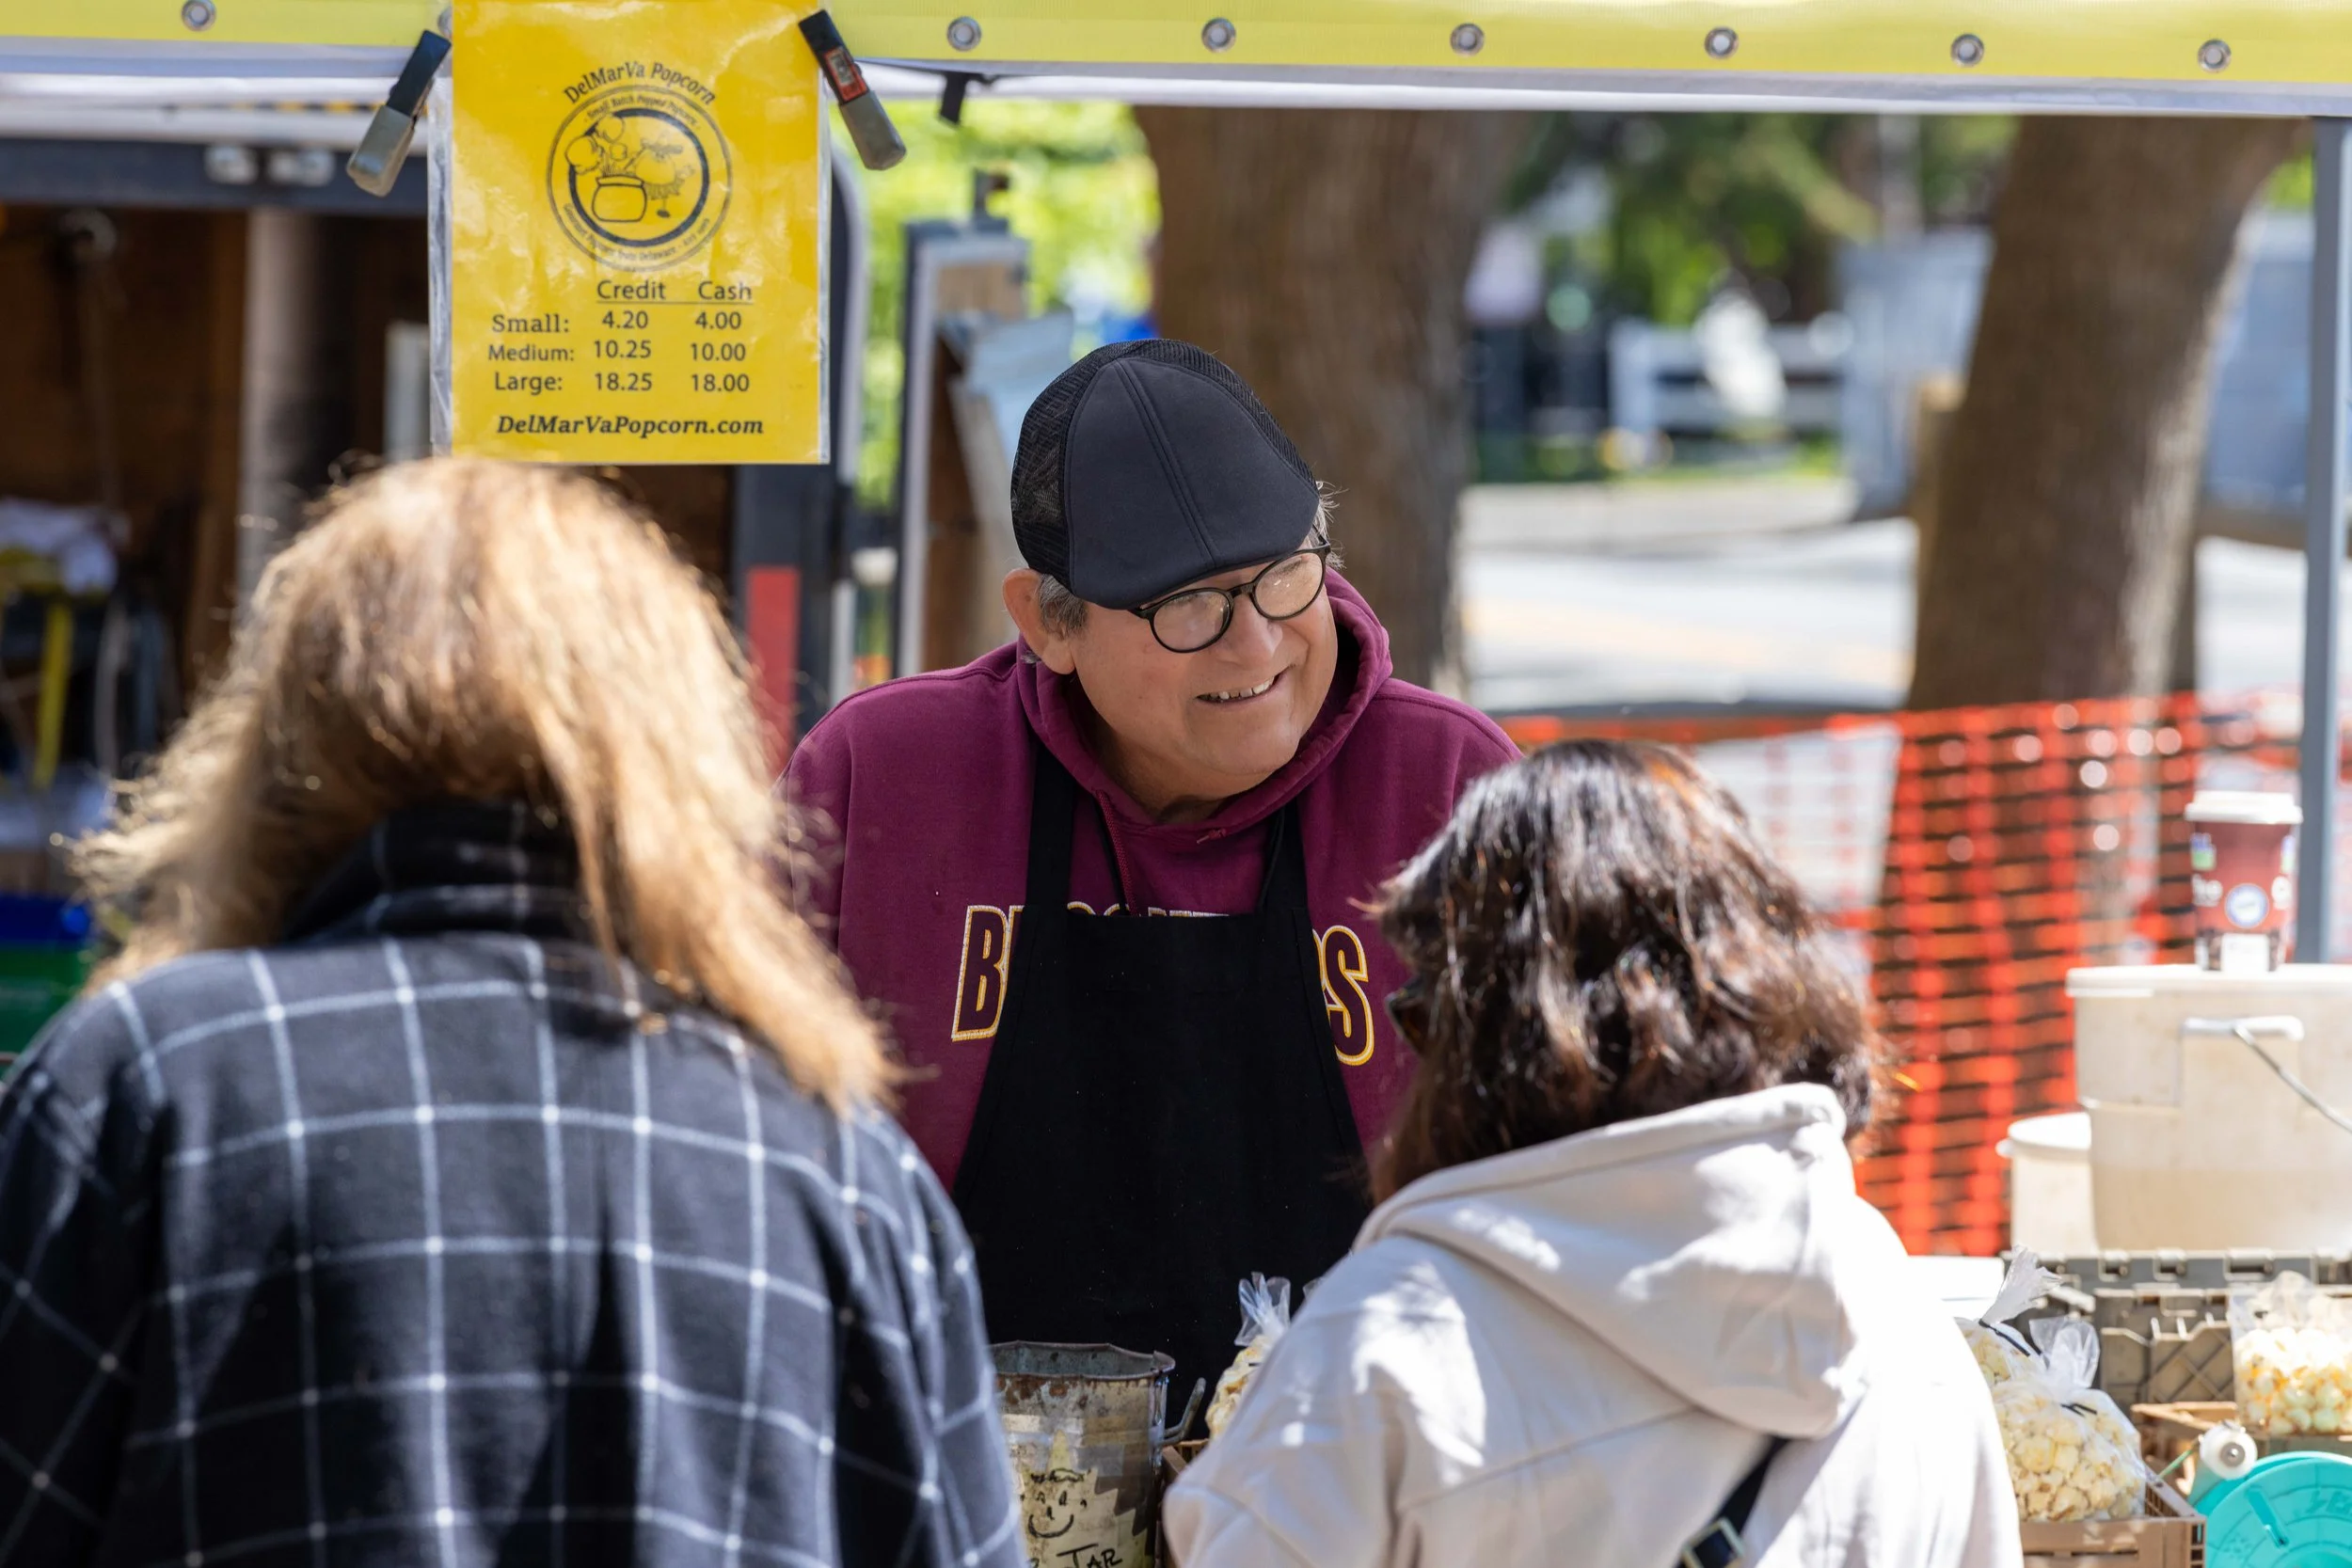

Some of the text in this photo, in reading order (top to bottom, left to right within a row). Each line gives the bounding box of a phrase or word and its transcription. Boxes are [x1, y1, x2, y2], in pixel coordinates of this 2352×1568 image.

[564, 61, 716, 105] DelMarVa Popcorn
[596, 280, 753, 301] Credit Cash
[492, 310, 742, 334] Small: 4.20 4.00
[488, 340, 746, 362] Medium: 10.25 10.00
[494, 372, 750, 396] Large: 18.25 18.00
[496, 414, 764, 439] DelMarVaPopcorn.com
